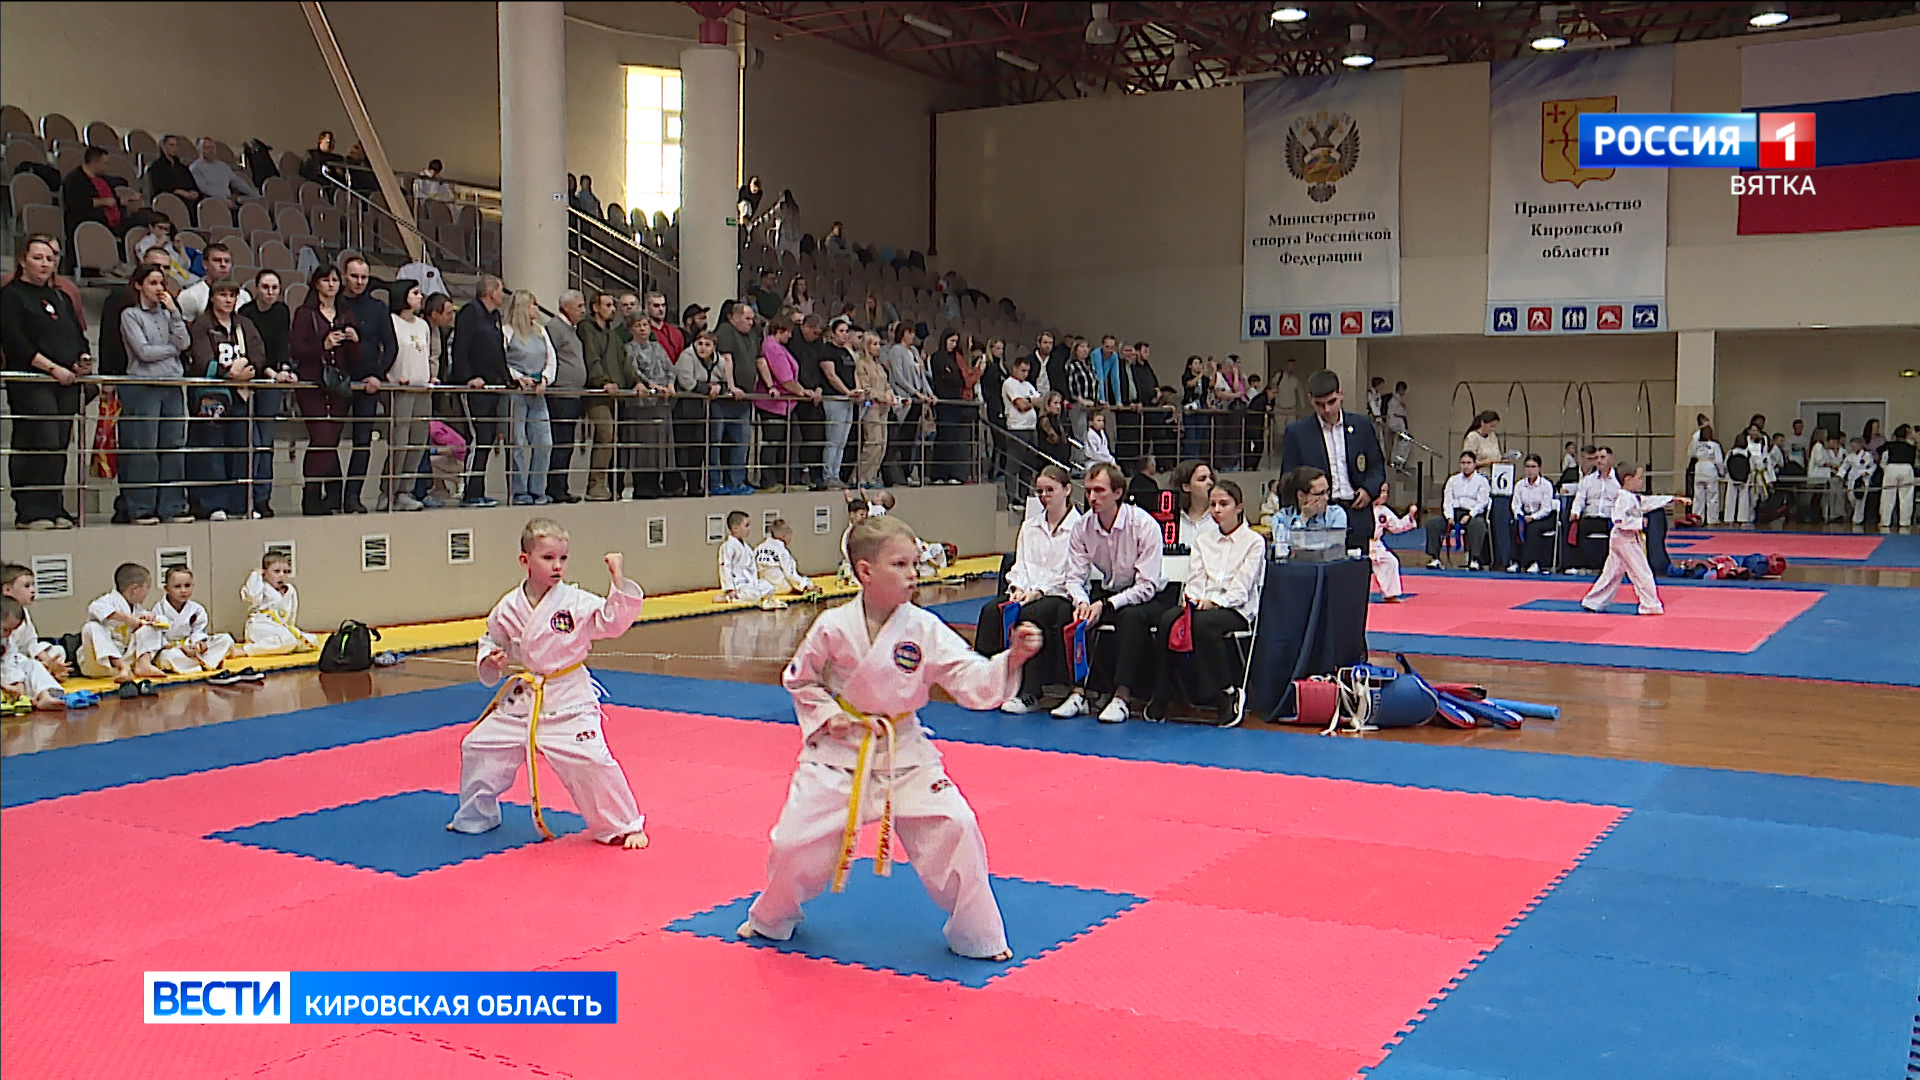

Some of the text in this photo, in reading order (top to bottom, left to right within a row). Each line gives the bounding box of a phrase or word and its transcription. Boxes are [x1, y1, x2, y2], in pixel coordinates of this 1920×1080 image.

[1514, 198, 1642, 217] Правительство
[1268, 210, 1376, 226] Министерство
[1252, 226, 1392, 248] спорта Российской
[1530, 221, 1623, 240] Кировской
[1279, 251, 1362, 266] Федерации
[1542, 245, 1610, 258] области
[1496, 471, 1508, 490] 6
[1160, 490, 1172, 513] 0
